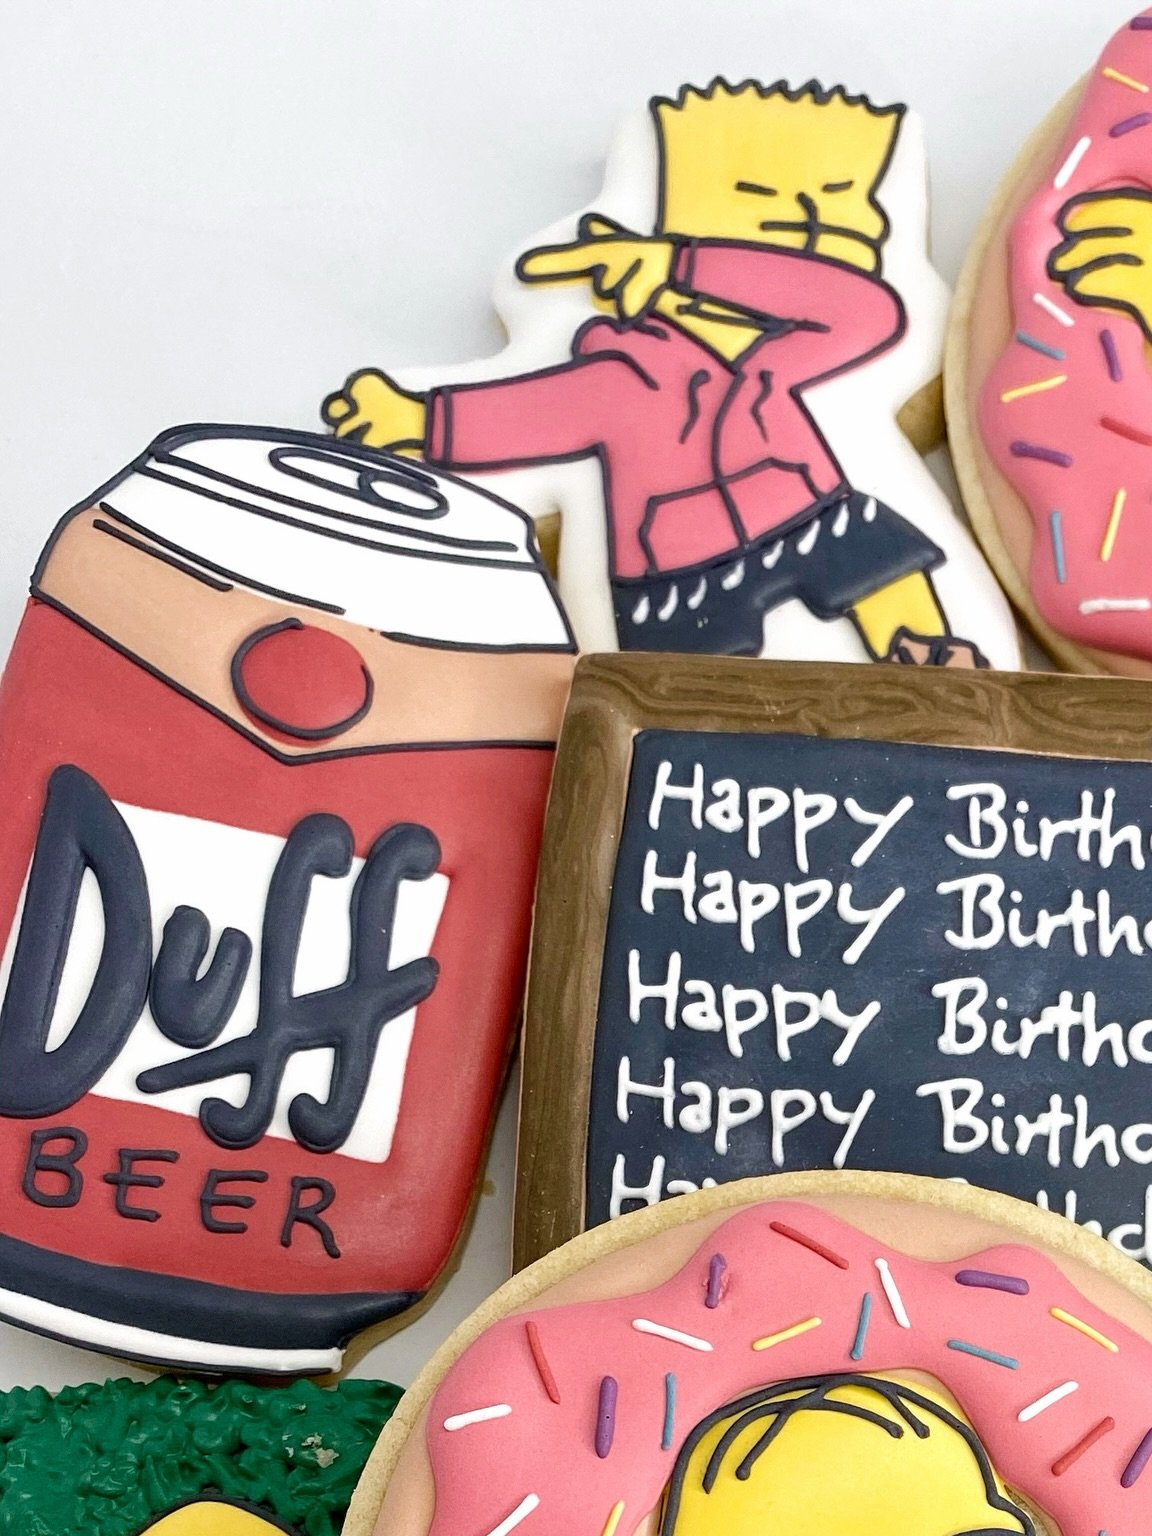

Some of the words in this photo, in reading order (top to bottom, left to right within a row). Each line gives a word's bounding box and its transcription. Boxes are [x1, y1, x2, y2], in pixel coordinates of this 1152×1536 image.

[648, 761, 914, 873] Happy
[0, 764, 441, 1151] Duff
[640, 850, 905, 965] Happy
[627, 948, 882, 1067] Happy
[616, 1055, 876, 1169] Happy
[21, 1127, 341, 1258] BEER
